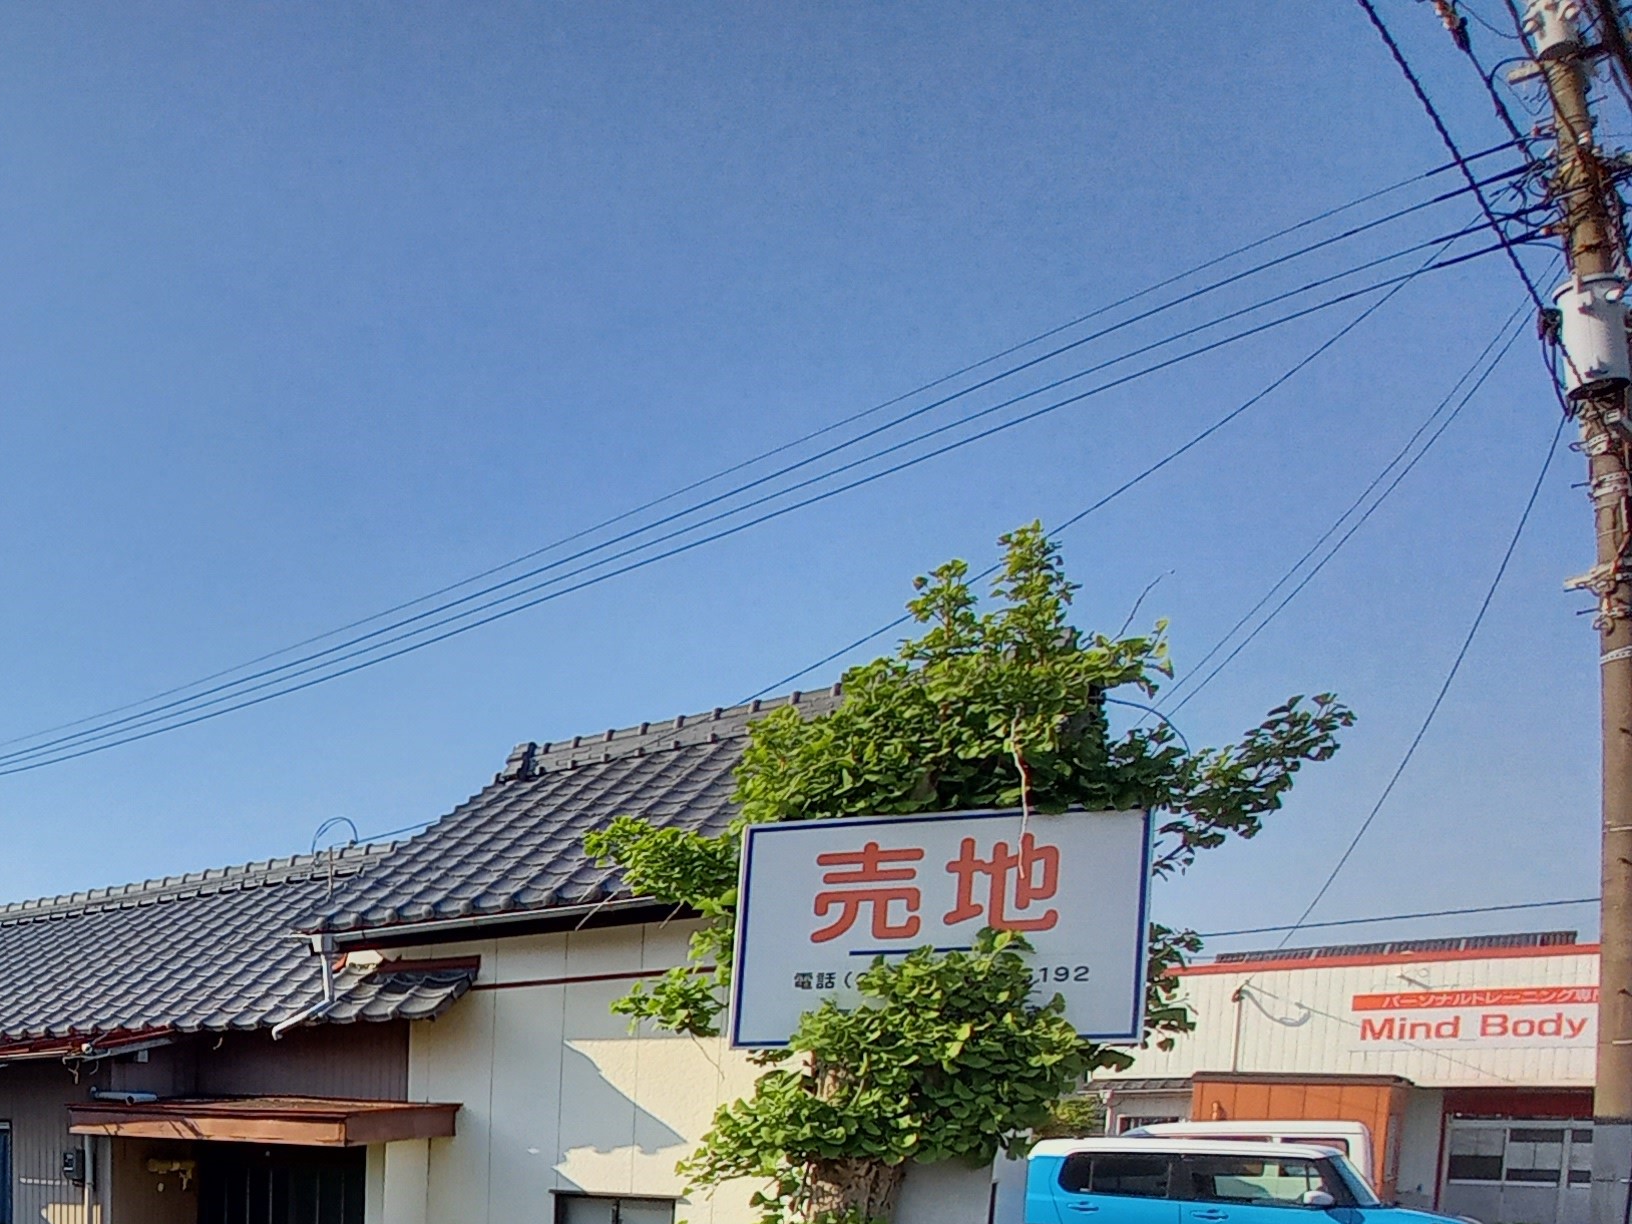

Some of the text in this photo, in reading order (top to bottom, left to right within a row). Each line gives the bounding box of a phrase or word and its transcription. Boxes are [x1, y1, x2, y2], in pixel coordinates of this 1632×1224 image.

[810, 833, 1061, 943] 売地
[1360, 1012, 1588, 1041] Mind Body
